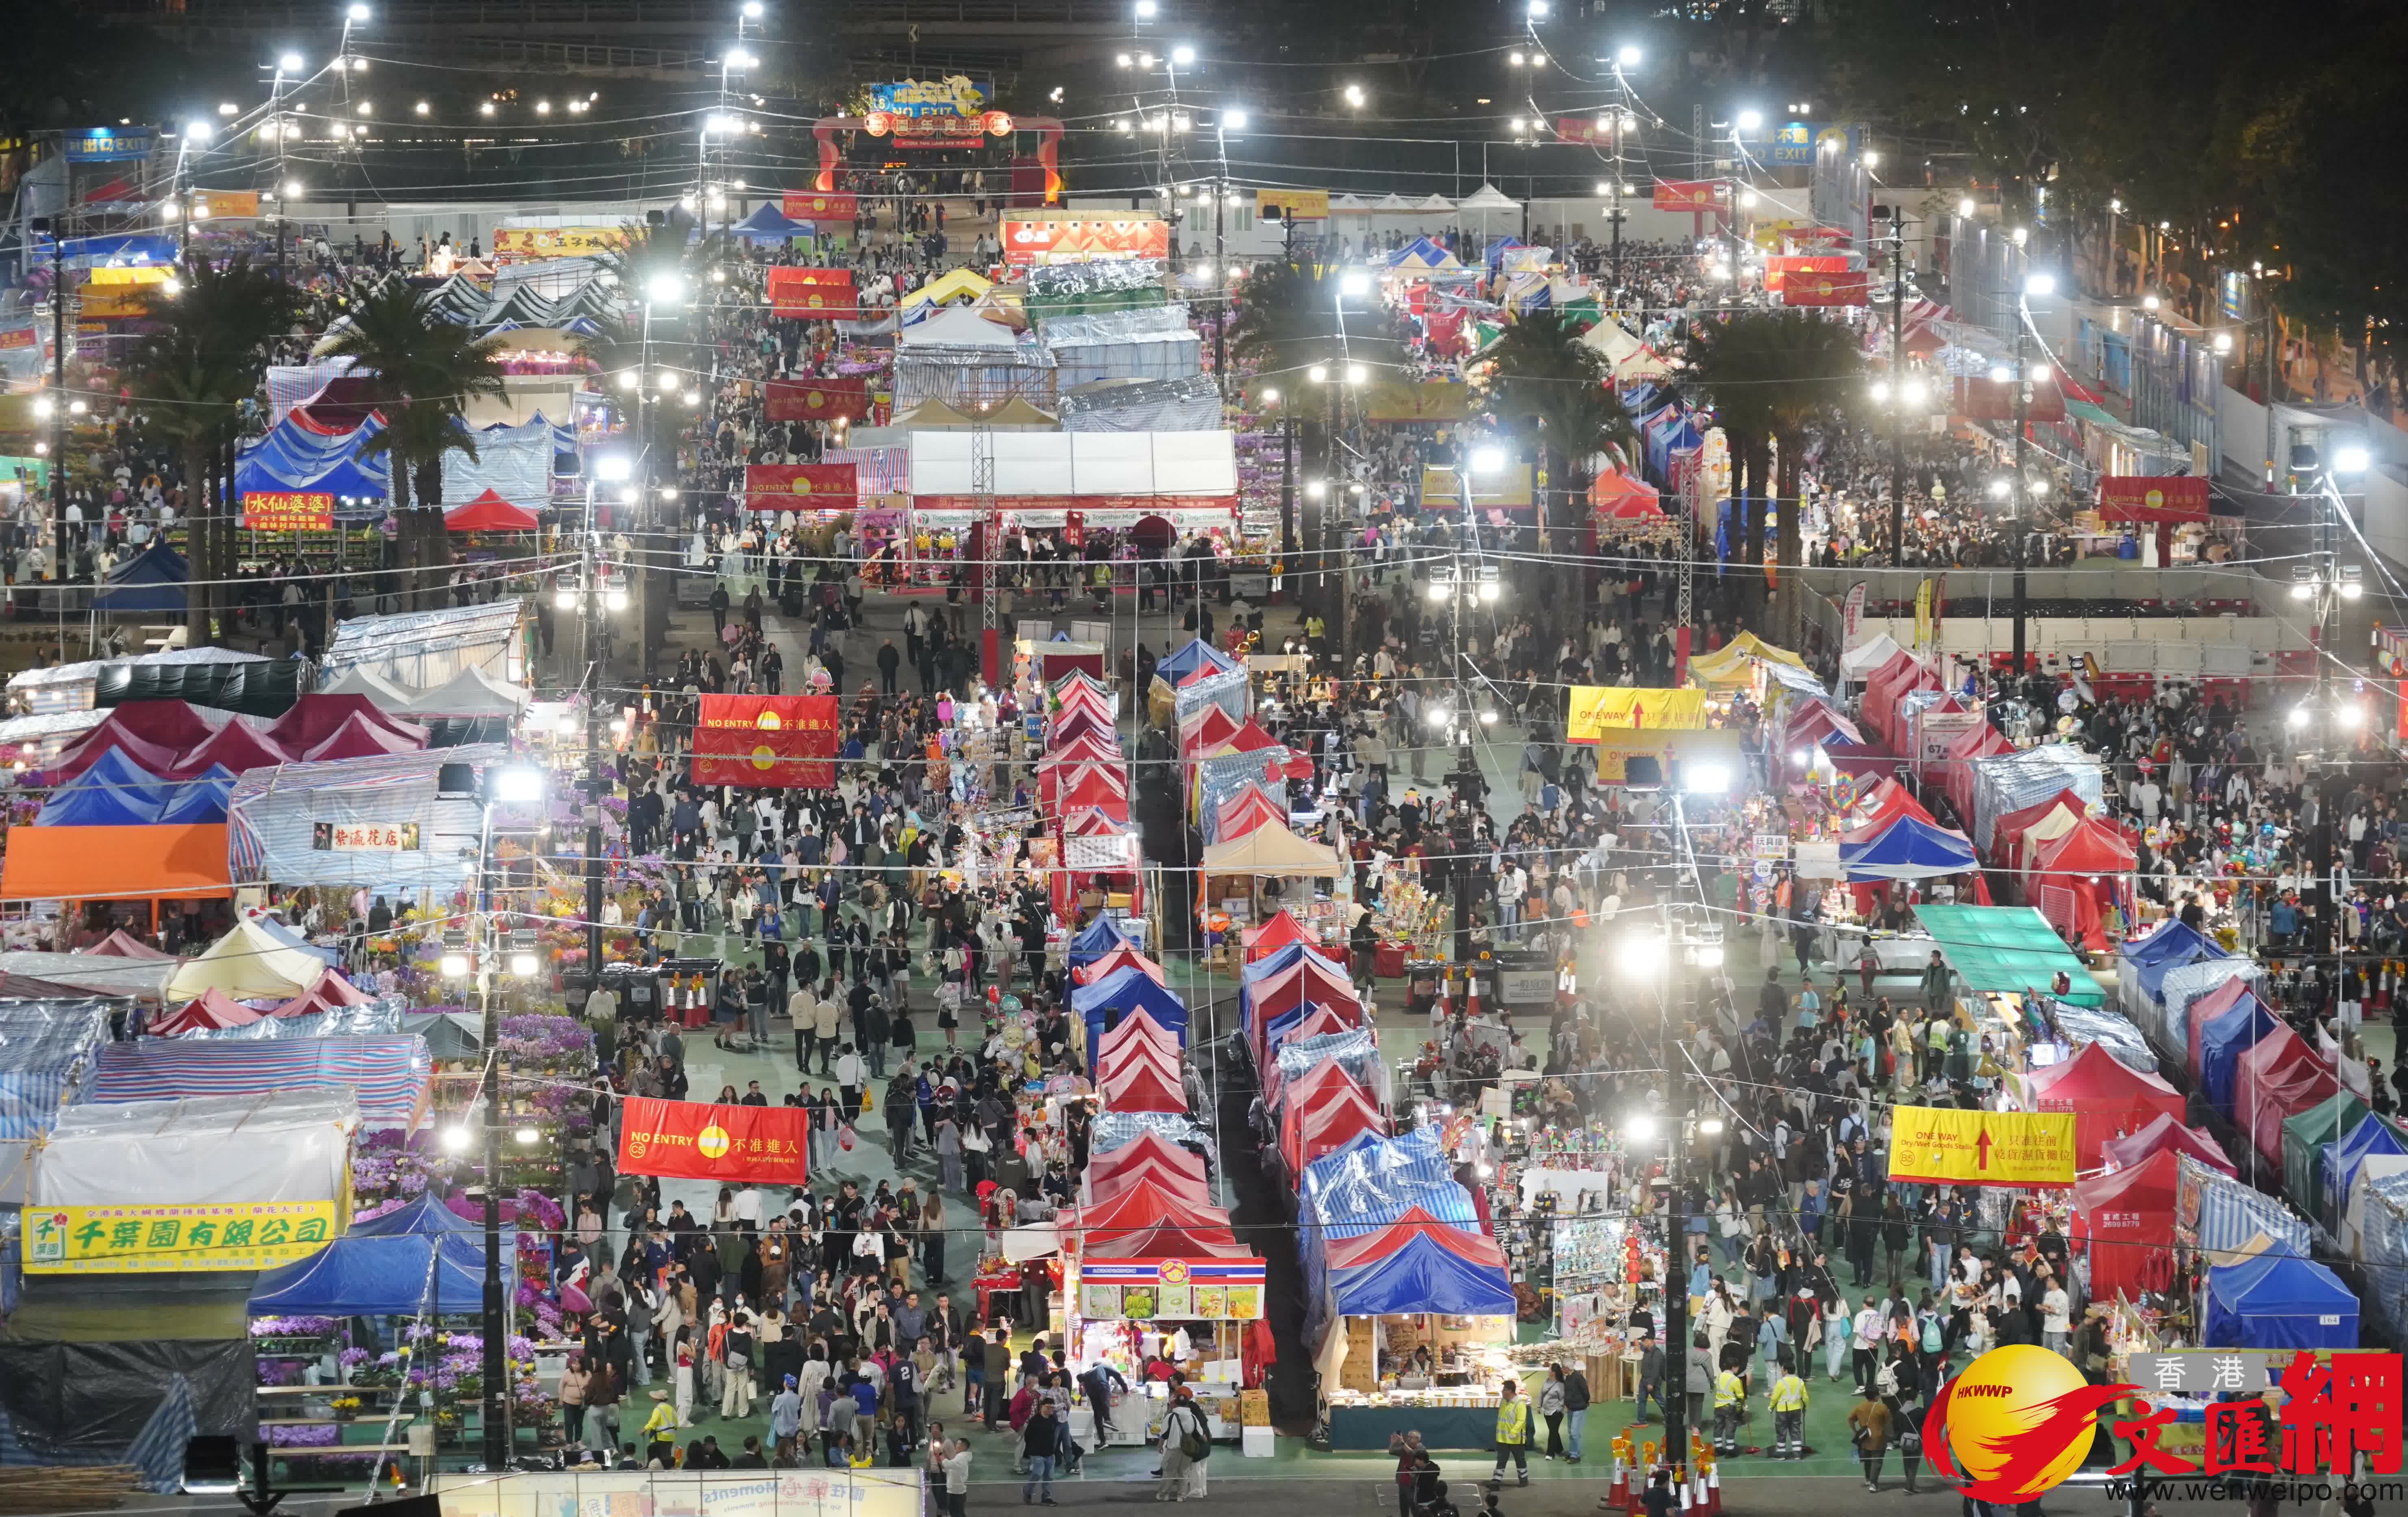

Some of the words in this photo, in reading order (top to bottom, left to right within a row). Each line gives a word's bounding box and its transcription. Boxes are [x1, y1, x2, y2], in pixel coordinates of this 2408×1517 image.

[893, 107, 913, 117] NO
[921, 107, 952, 115] EXIT
[83, 138, 113, 153] 出口
[116, 138, 147, 150] EXIT
[1775, 148, 1809, 159] EXIT
[1580, 711, 1600, 719] ONE
[1603, 712, 1626, 720] WAY
[724, 720, 753, 728] ENTRY
[783, 719, 831, 730] 不准進入
[631, 1131, 650, 1142] NO
[654, 1133, 694, 1146] ENTRY
[733, 1138, 798, 1154] 不准進入
[1916, 1132, 1935, 1140] ONE
[1938, 1133, 1958, 1142] WAY
[2009, 1135, 2057, 1146] 只准往前
[1901, 1139, 1931, 1148] Dry/Wet
[631, 1144, 645, 1155] C5
[1901, 1153, 1914, 1163] B5
[73, 1218, 327, 1250] 千葉園有限公司
[900, 1366, 910, 1380] 2
